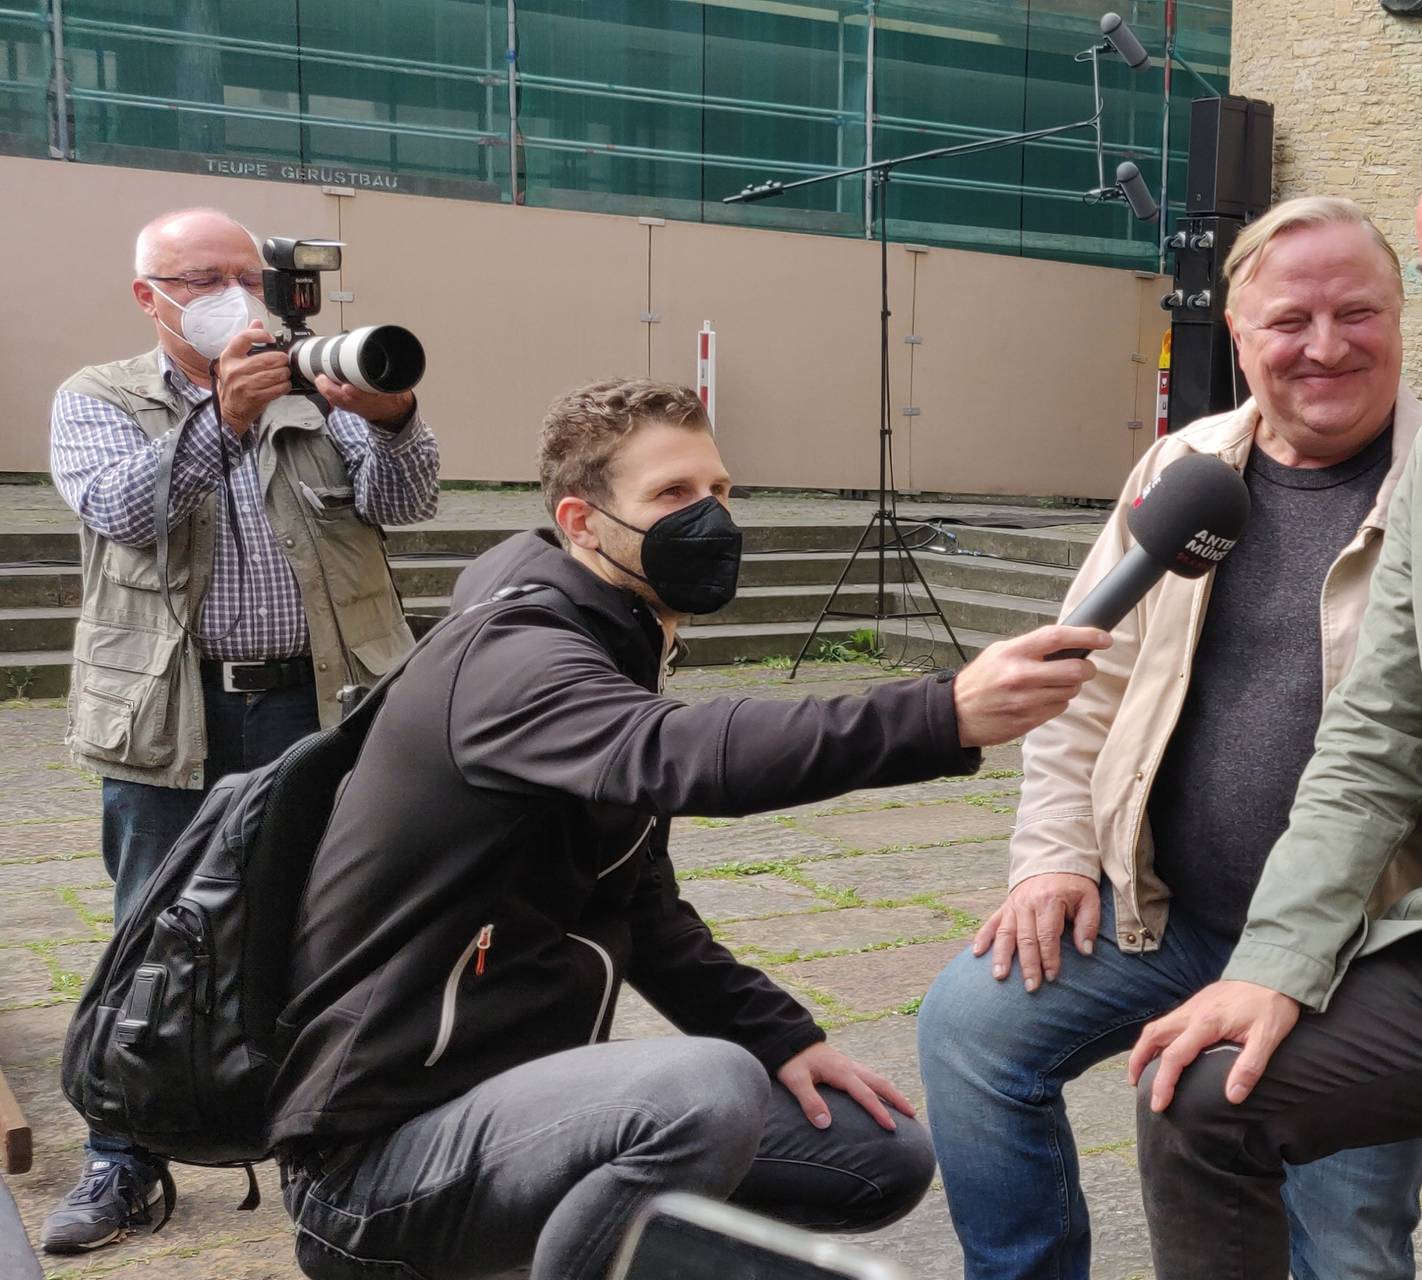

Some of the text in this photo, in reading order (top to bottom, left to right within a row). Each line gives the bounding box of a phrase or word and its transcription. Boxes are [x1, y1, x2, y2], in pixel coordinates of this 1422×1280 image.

[206, 159, 268, 176] TEUPE
[1185, 539, 1229, 561] MÜNS
[1194, 529, 1237, 550] ANTE
